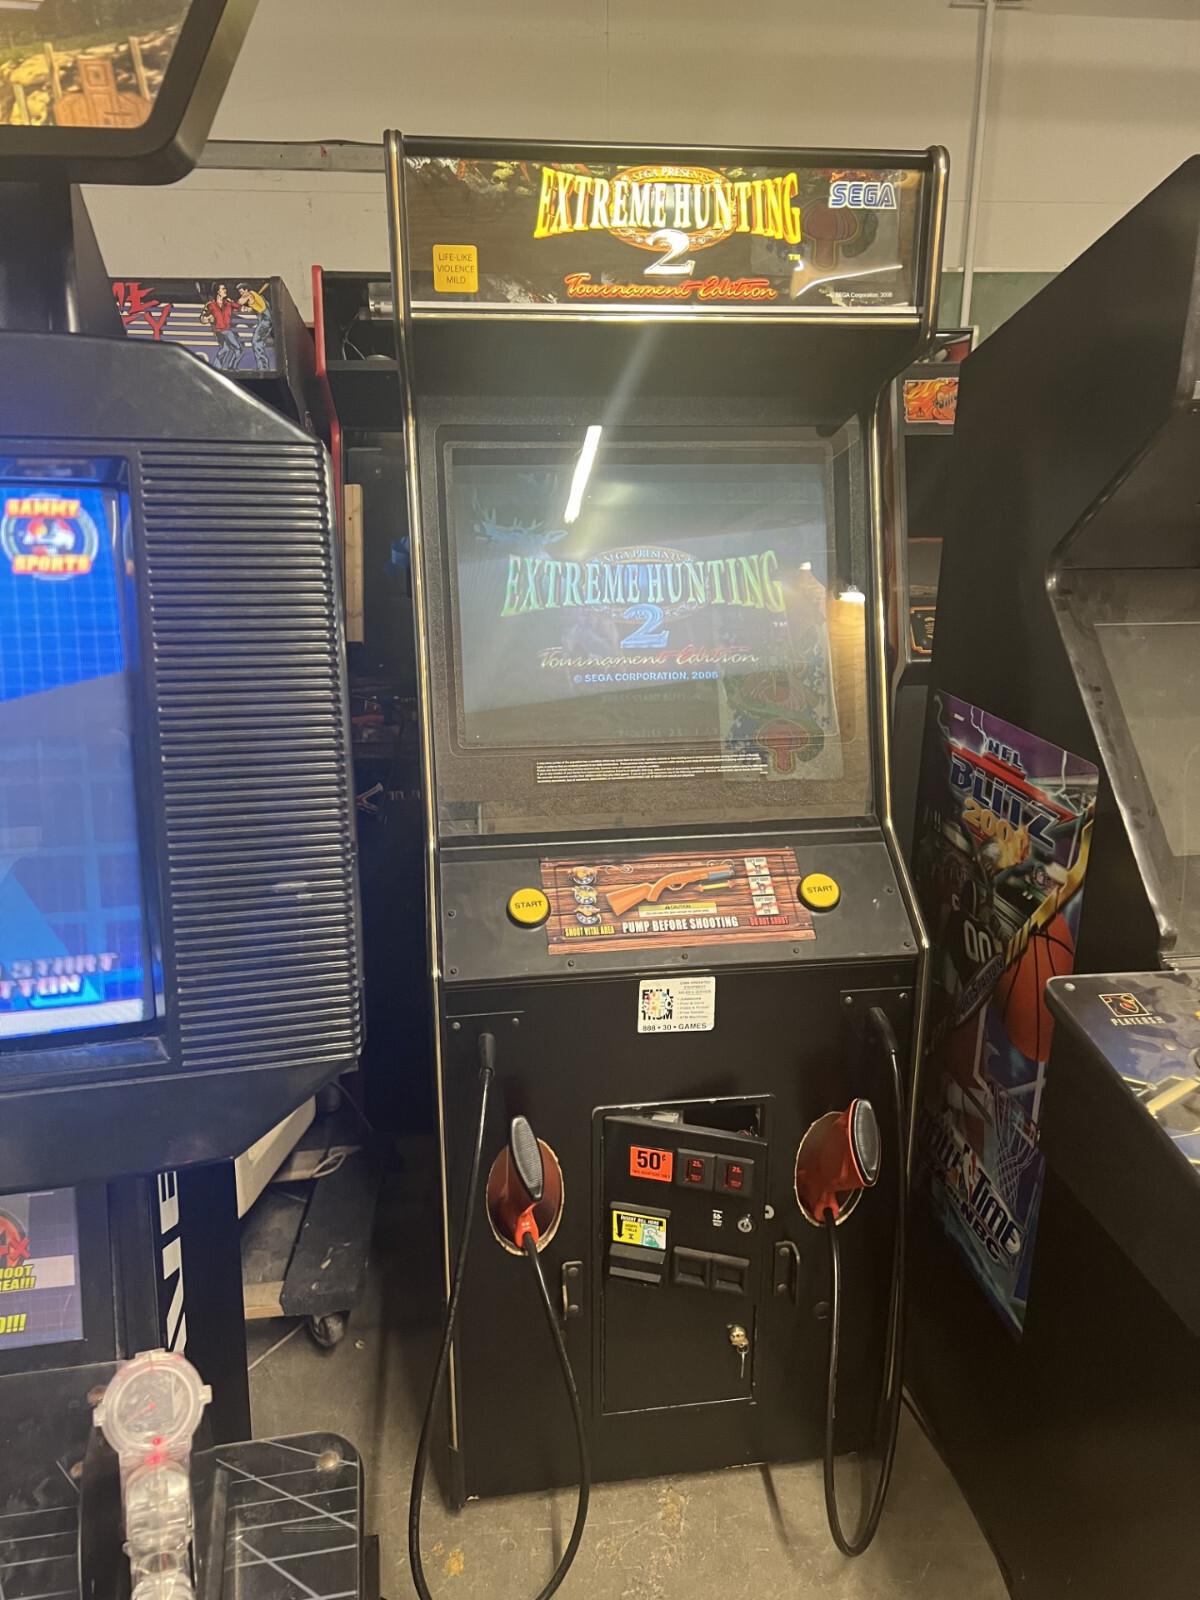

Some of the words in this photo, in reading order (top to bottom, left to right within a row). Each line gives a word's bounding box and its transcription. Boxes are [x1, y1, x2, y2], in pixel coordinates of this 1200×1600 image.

[829, 182, 897, 209] SEGA
[534, 167, 667, 239] EXTREME
[672, 172, 801, 245] HUNTING
[438, 253, 473, 262] LIFE-LIKE
[644, 228, 695, 276] 2
[437, 264, 475, 273] VIOLENCE
[446, 275, 466, 285] MILD
[565, 272, 692, 300] Tournament
[694, 274, 778, 299] Edition
[13, 554, 92, 574] SPORTS
[500, 554, 640, 618] EXTREME
[646, 550, 786, 613] HUNTING
[620, 603, 670, 649] 2
[538, 646, 666, 669] Tournament
[585, 673, 613, 683] SEGA
[692, 671, 719, 680] 2006
[987, 738, 1024, 771] NFL
[807, 885, 833, 894] START
[514, 900, 543, 909] START
[622, 921, 650, 934] PUMP
[652, 918, 688, 932] BEFORE
[689, 915, 739, 930] SHOOTING
[750, 917, 759, 926] DO
[759, 917, 770, 925] NOT
[770, 916, 789, 925] SHOOT
[565, 927, 583, 937] SHOOT
[584, 926, 600, 936] VITAL
[600, 925, 616, 935] AREA
